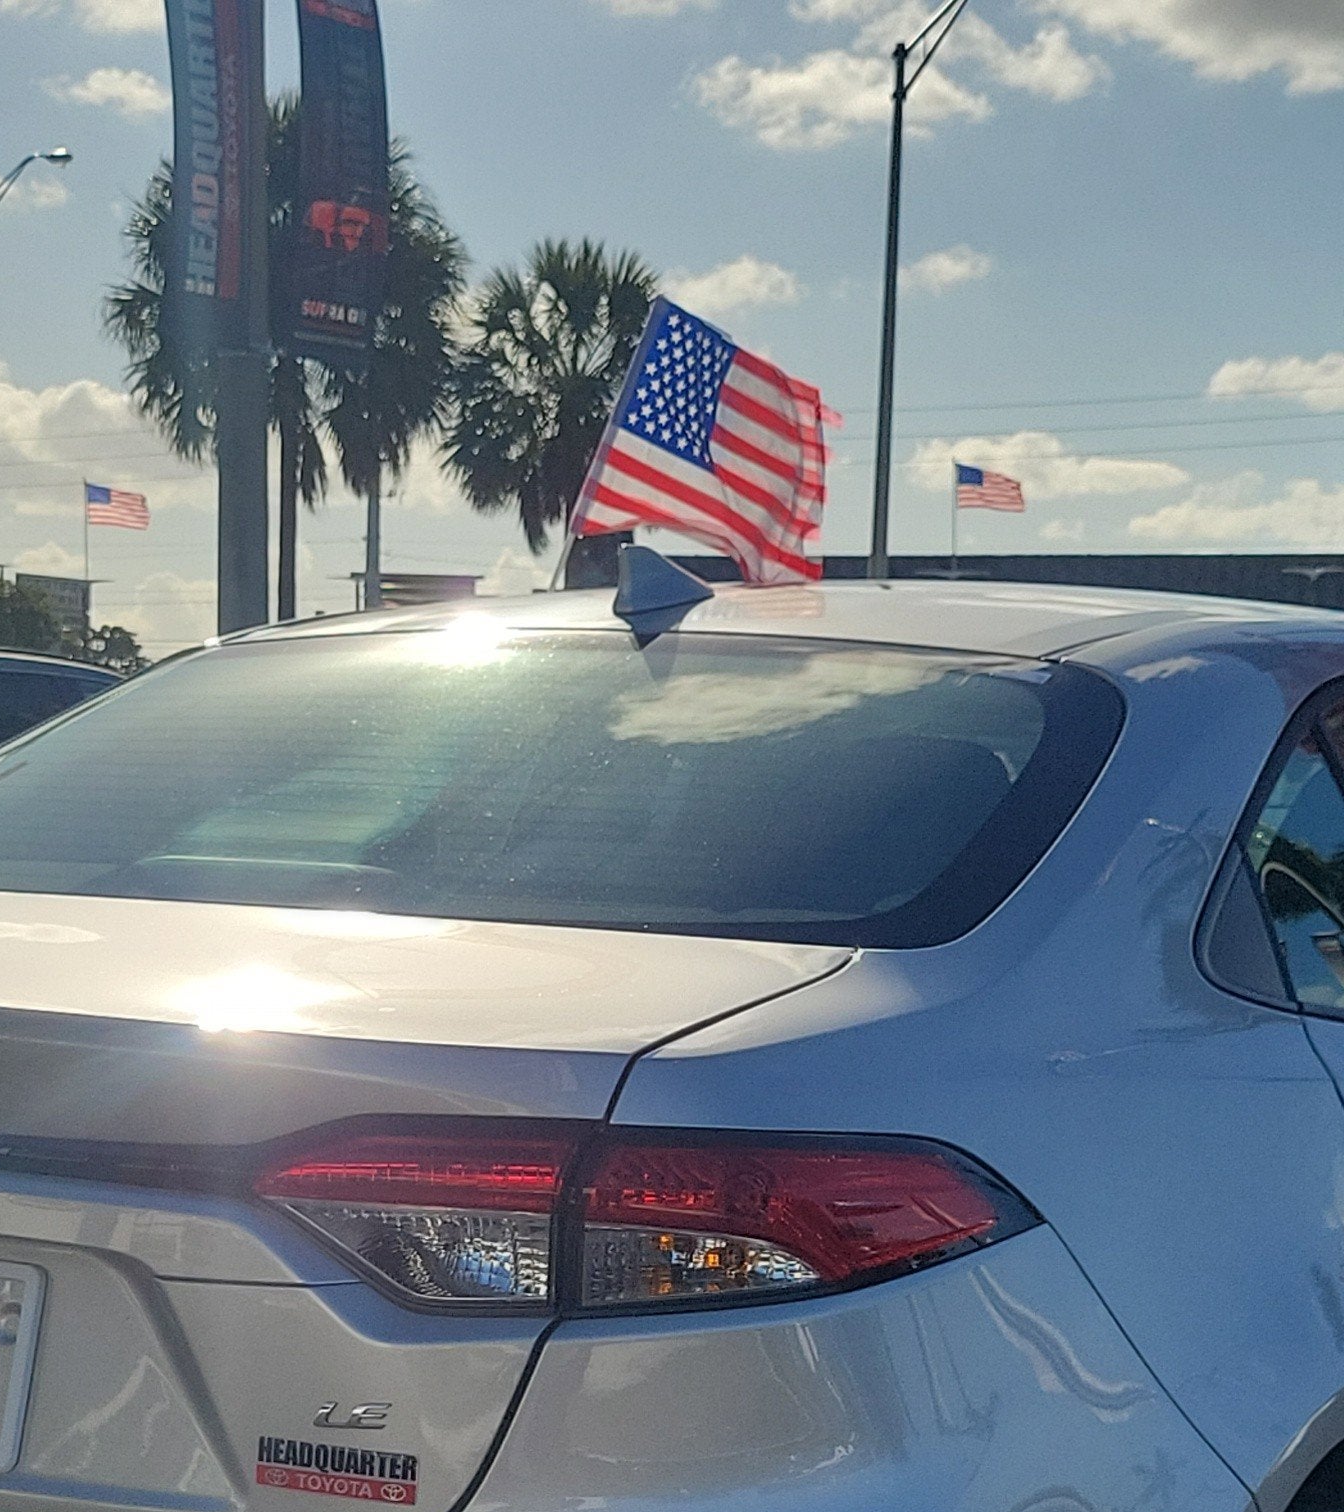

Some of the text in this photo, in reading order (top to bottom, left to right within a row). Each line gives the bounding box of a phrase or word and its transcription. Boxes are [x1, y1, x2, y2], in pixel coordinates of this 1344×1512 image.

[313, 1401, 393, 1429] LE
[258, 1436, 417, 1481] HEADQUARTER
[296, 1473, 374, 1499] TOYOTA
